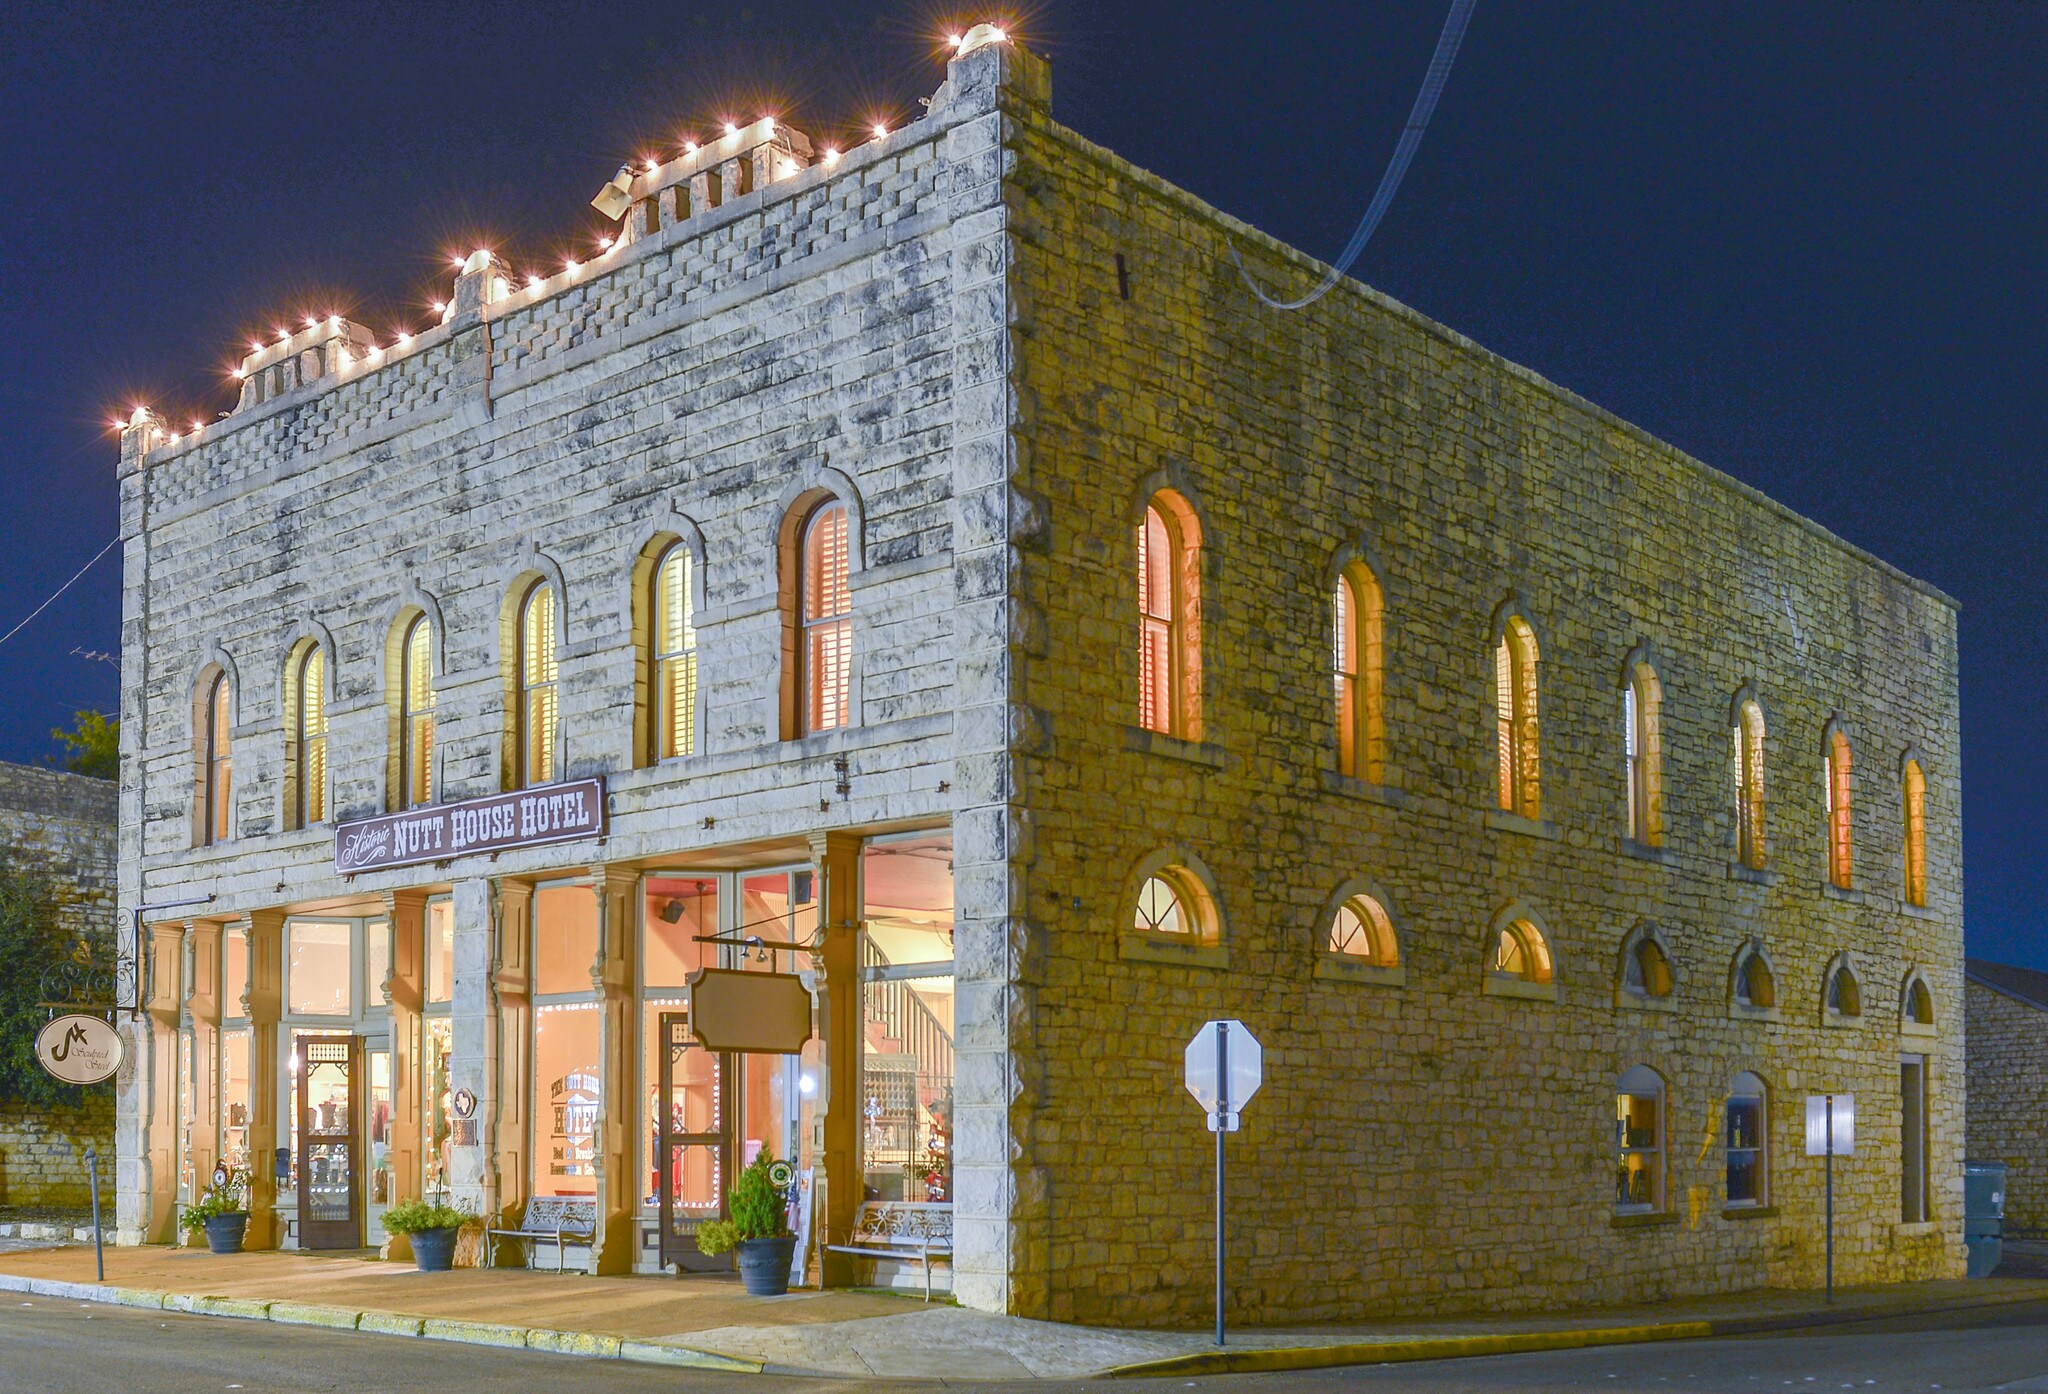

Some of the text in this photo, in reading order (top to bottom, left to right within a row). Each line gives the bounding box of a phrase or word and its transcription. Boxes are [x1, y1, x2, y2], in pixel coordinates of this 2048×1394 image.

[342, 791, 589, 865] Historic NUTT HOUSE HOTEL
[71, 1047, 109, 1060] Sculpted
[85, 1060, 111, 1070] Steel
